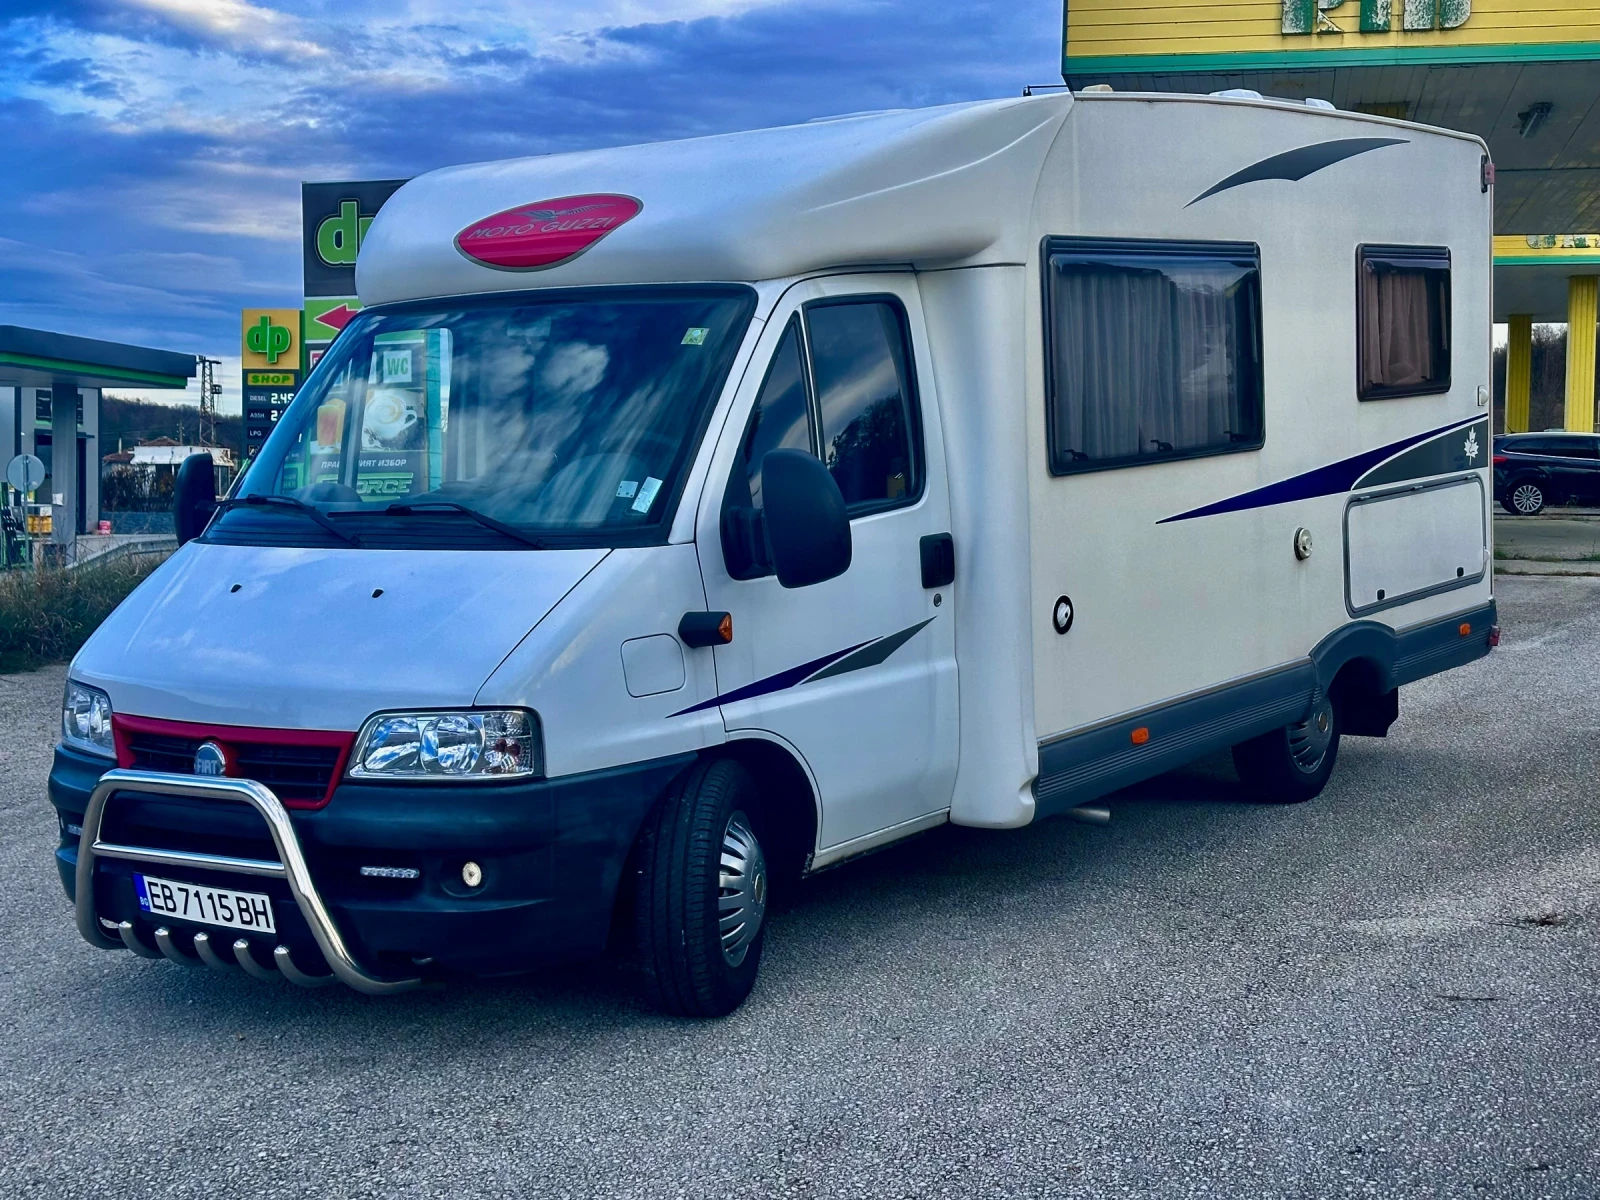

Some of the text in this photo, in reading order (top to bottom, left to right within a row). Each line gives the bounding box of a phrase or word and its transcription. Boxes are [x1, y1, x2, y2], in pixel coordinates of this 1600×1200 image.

[467, 217, 617, 240] MOTO GUZZI
[246, 316, 290, 363] dp
[387, 358, 408, 376] WC
[251, 375, 291, 384] SHOP
[377, 459, 407, 467] ИЗБОР
[197, 759, 218, 775] FIAT
[140, 896, 149, 906] BG
